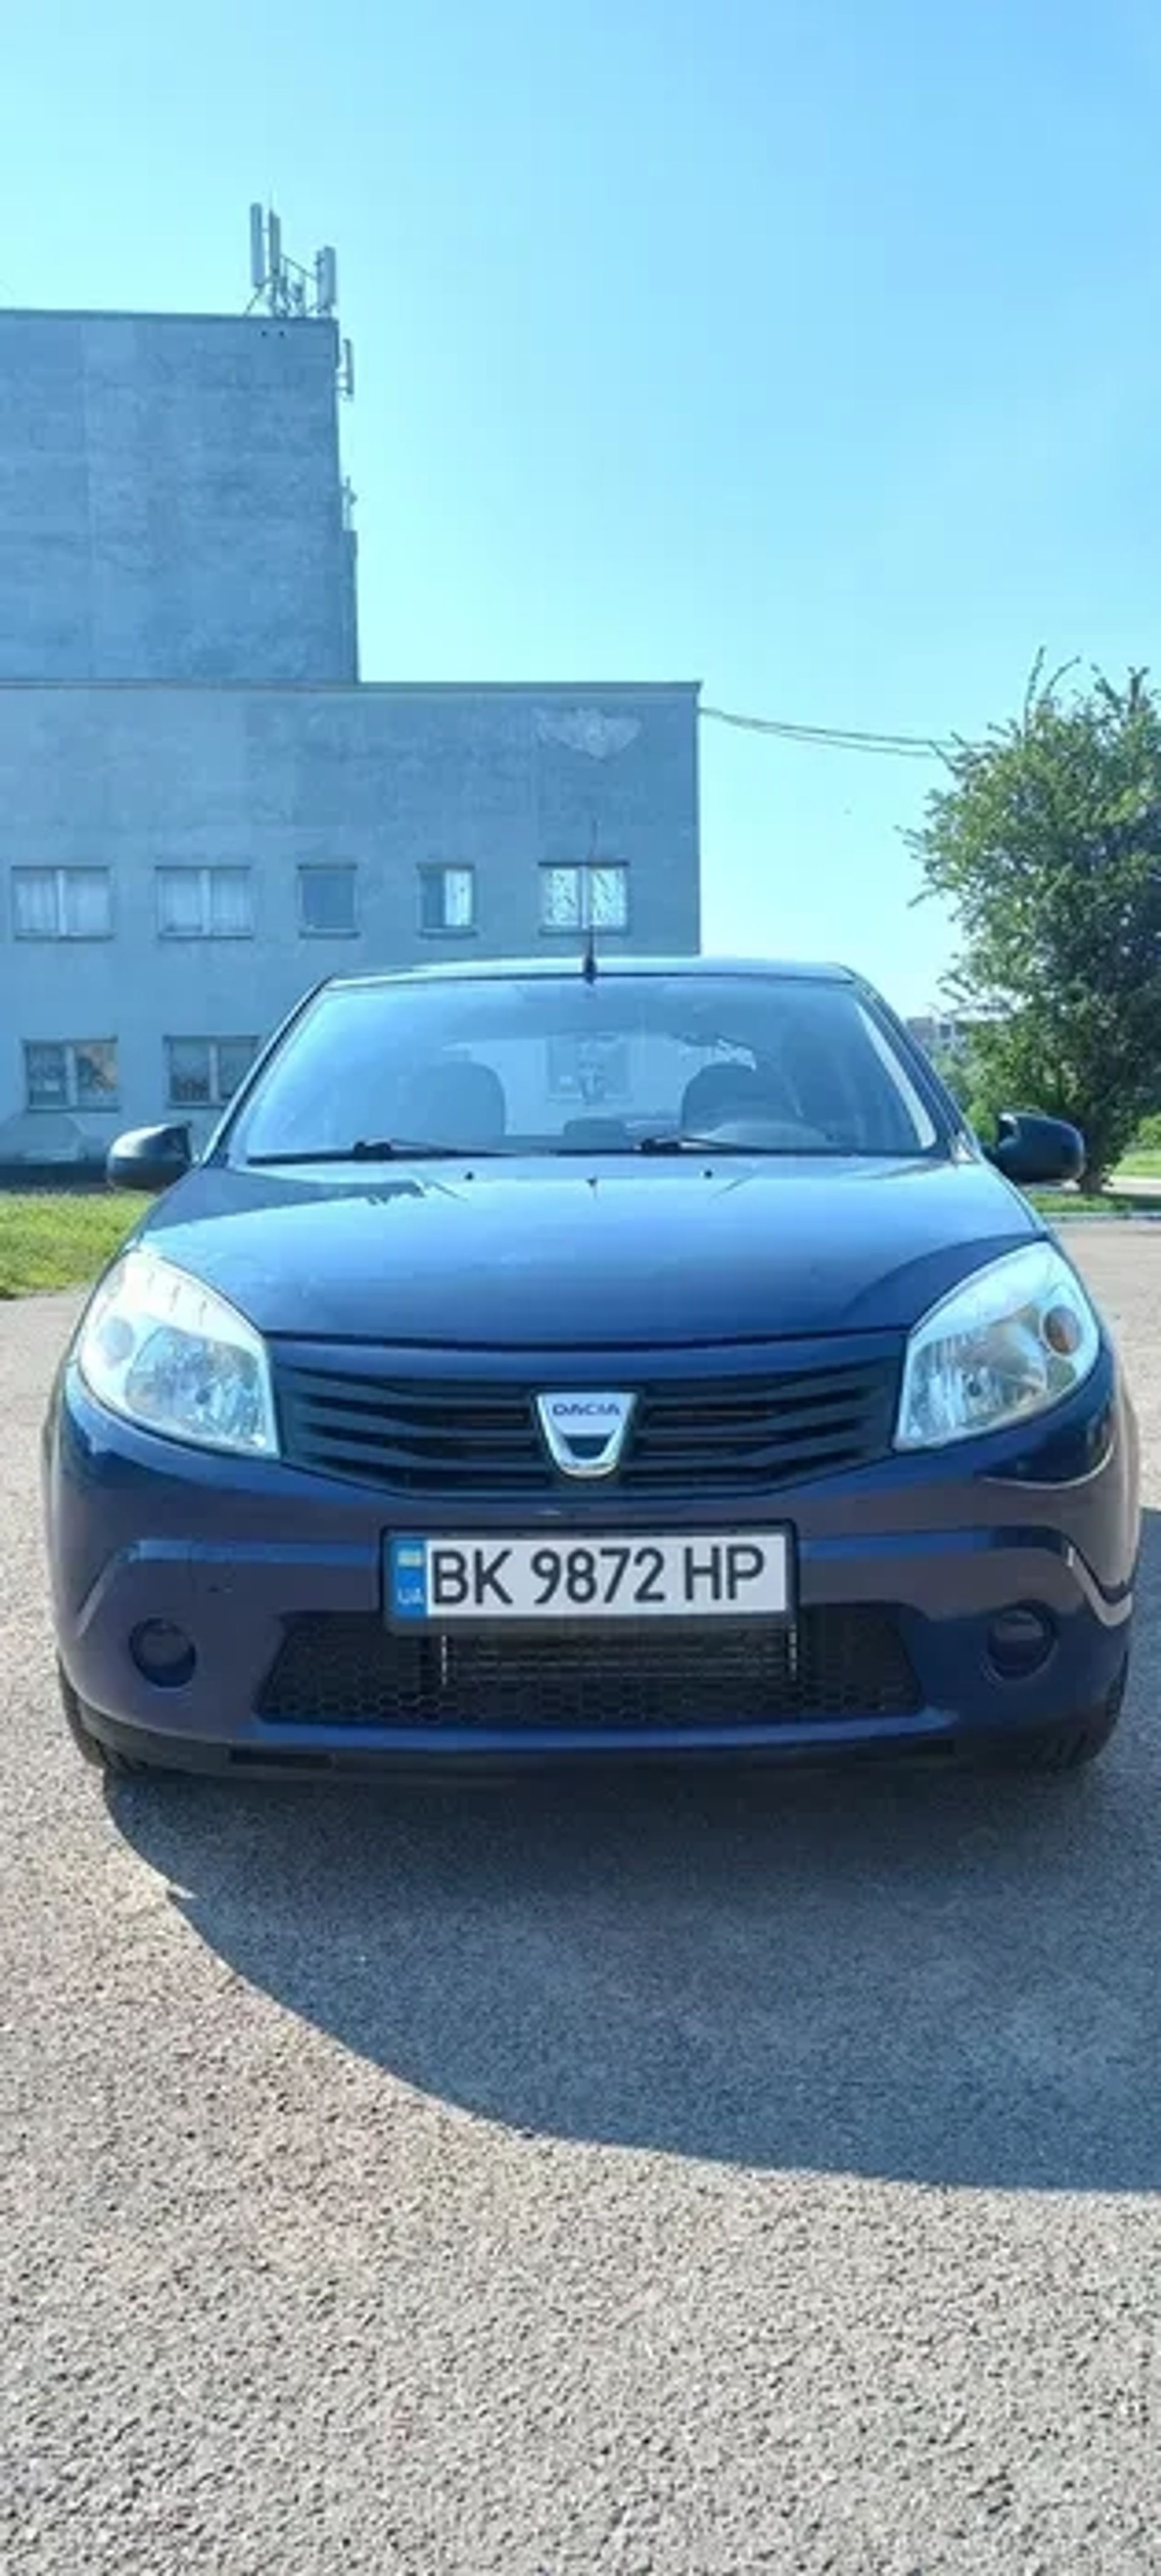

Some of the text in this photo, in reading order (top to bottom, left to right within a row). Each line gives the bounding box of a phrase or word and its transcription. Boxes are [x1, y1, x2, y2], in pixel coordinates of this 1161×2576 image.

[552, 1403, 620, 1416] DACIA
[431, 1544, 765, 1604] BK 9872 HP
[397, 1588, 423, 1604] UA
